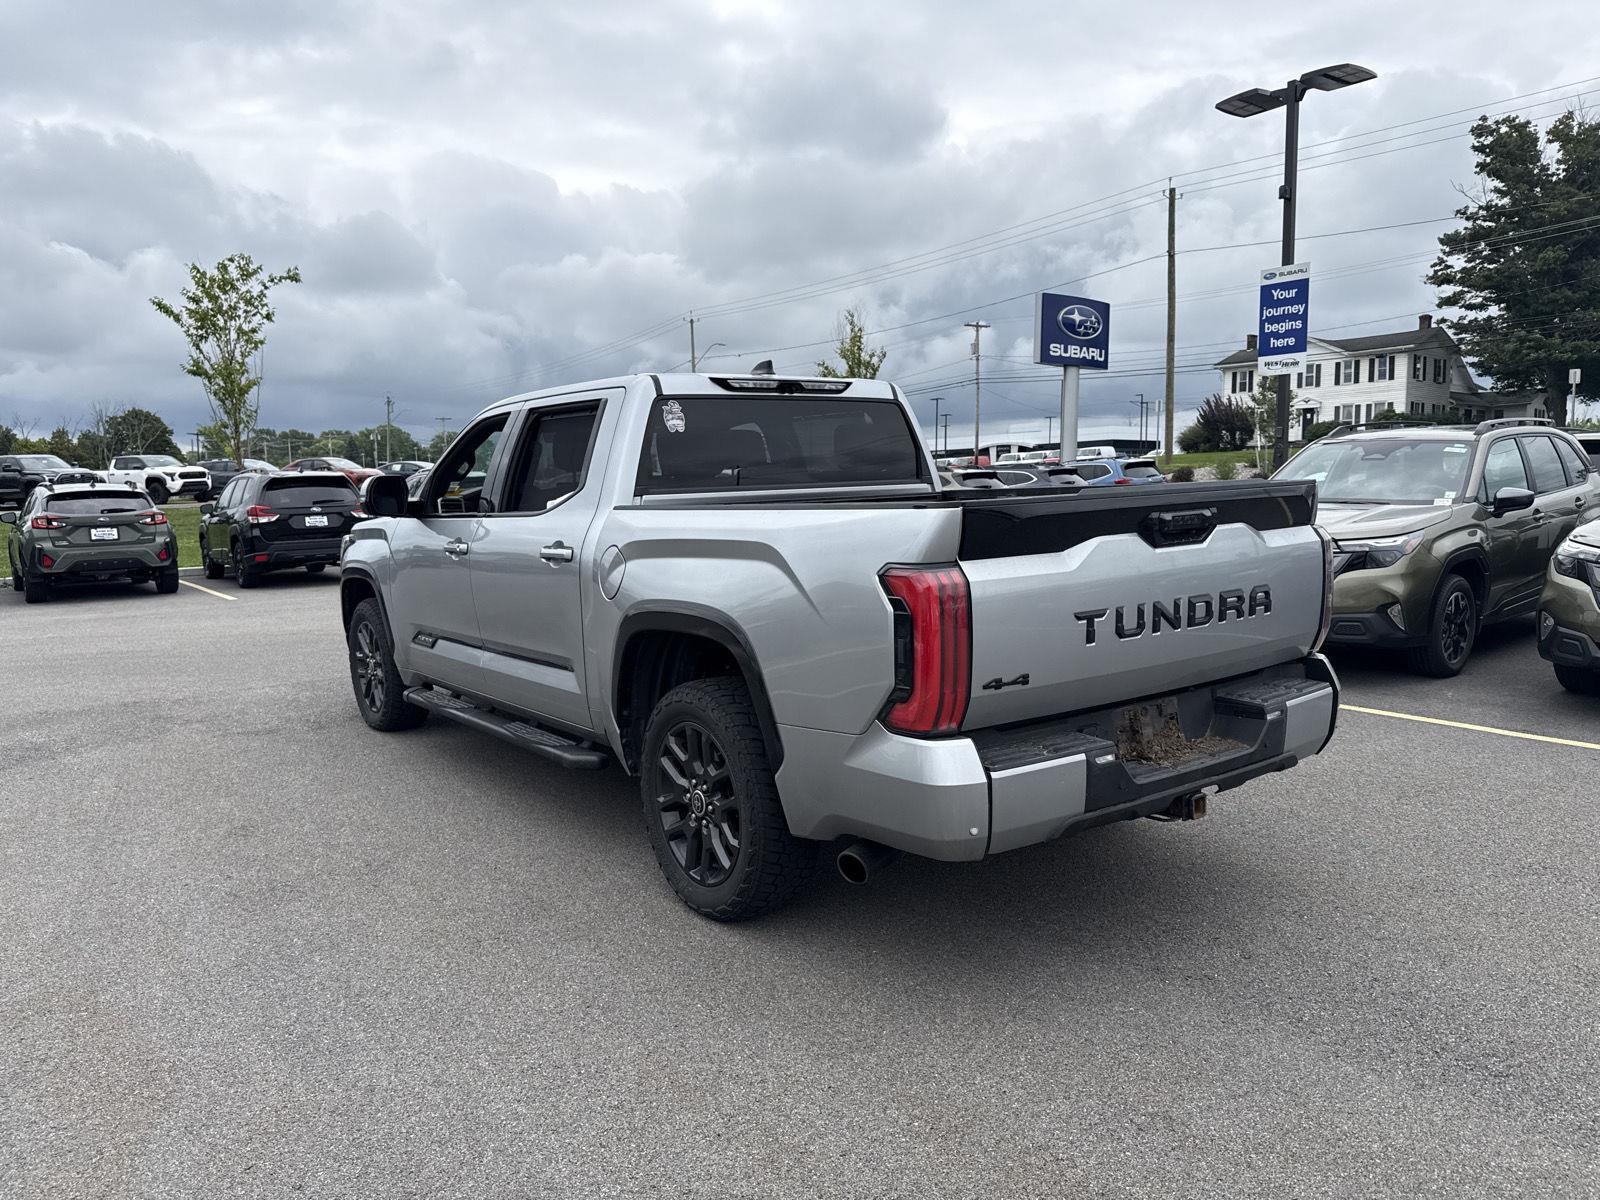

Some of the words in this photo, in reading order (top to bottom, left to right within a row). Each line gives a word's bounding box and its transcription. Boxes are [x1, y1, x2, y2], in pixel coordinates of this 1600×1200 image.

[1278, 267, 1308, 277] SUBARU
[1271, 288, 1298, 300] Your
[1262, 303, 1306, 320] journey
[1264, 319, 1303, 334] begins
[1270, 337, 1296, 348] here
[1049, 343, 1105, 362] SUBARU
[1073, 584, 1272, 647] TUNDRA
